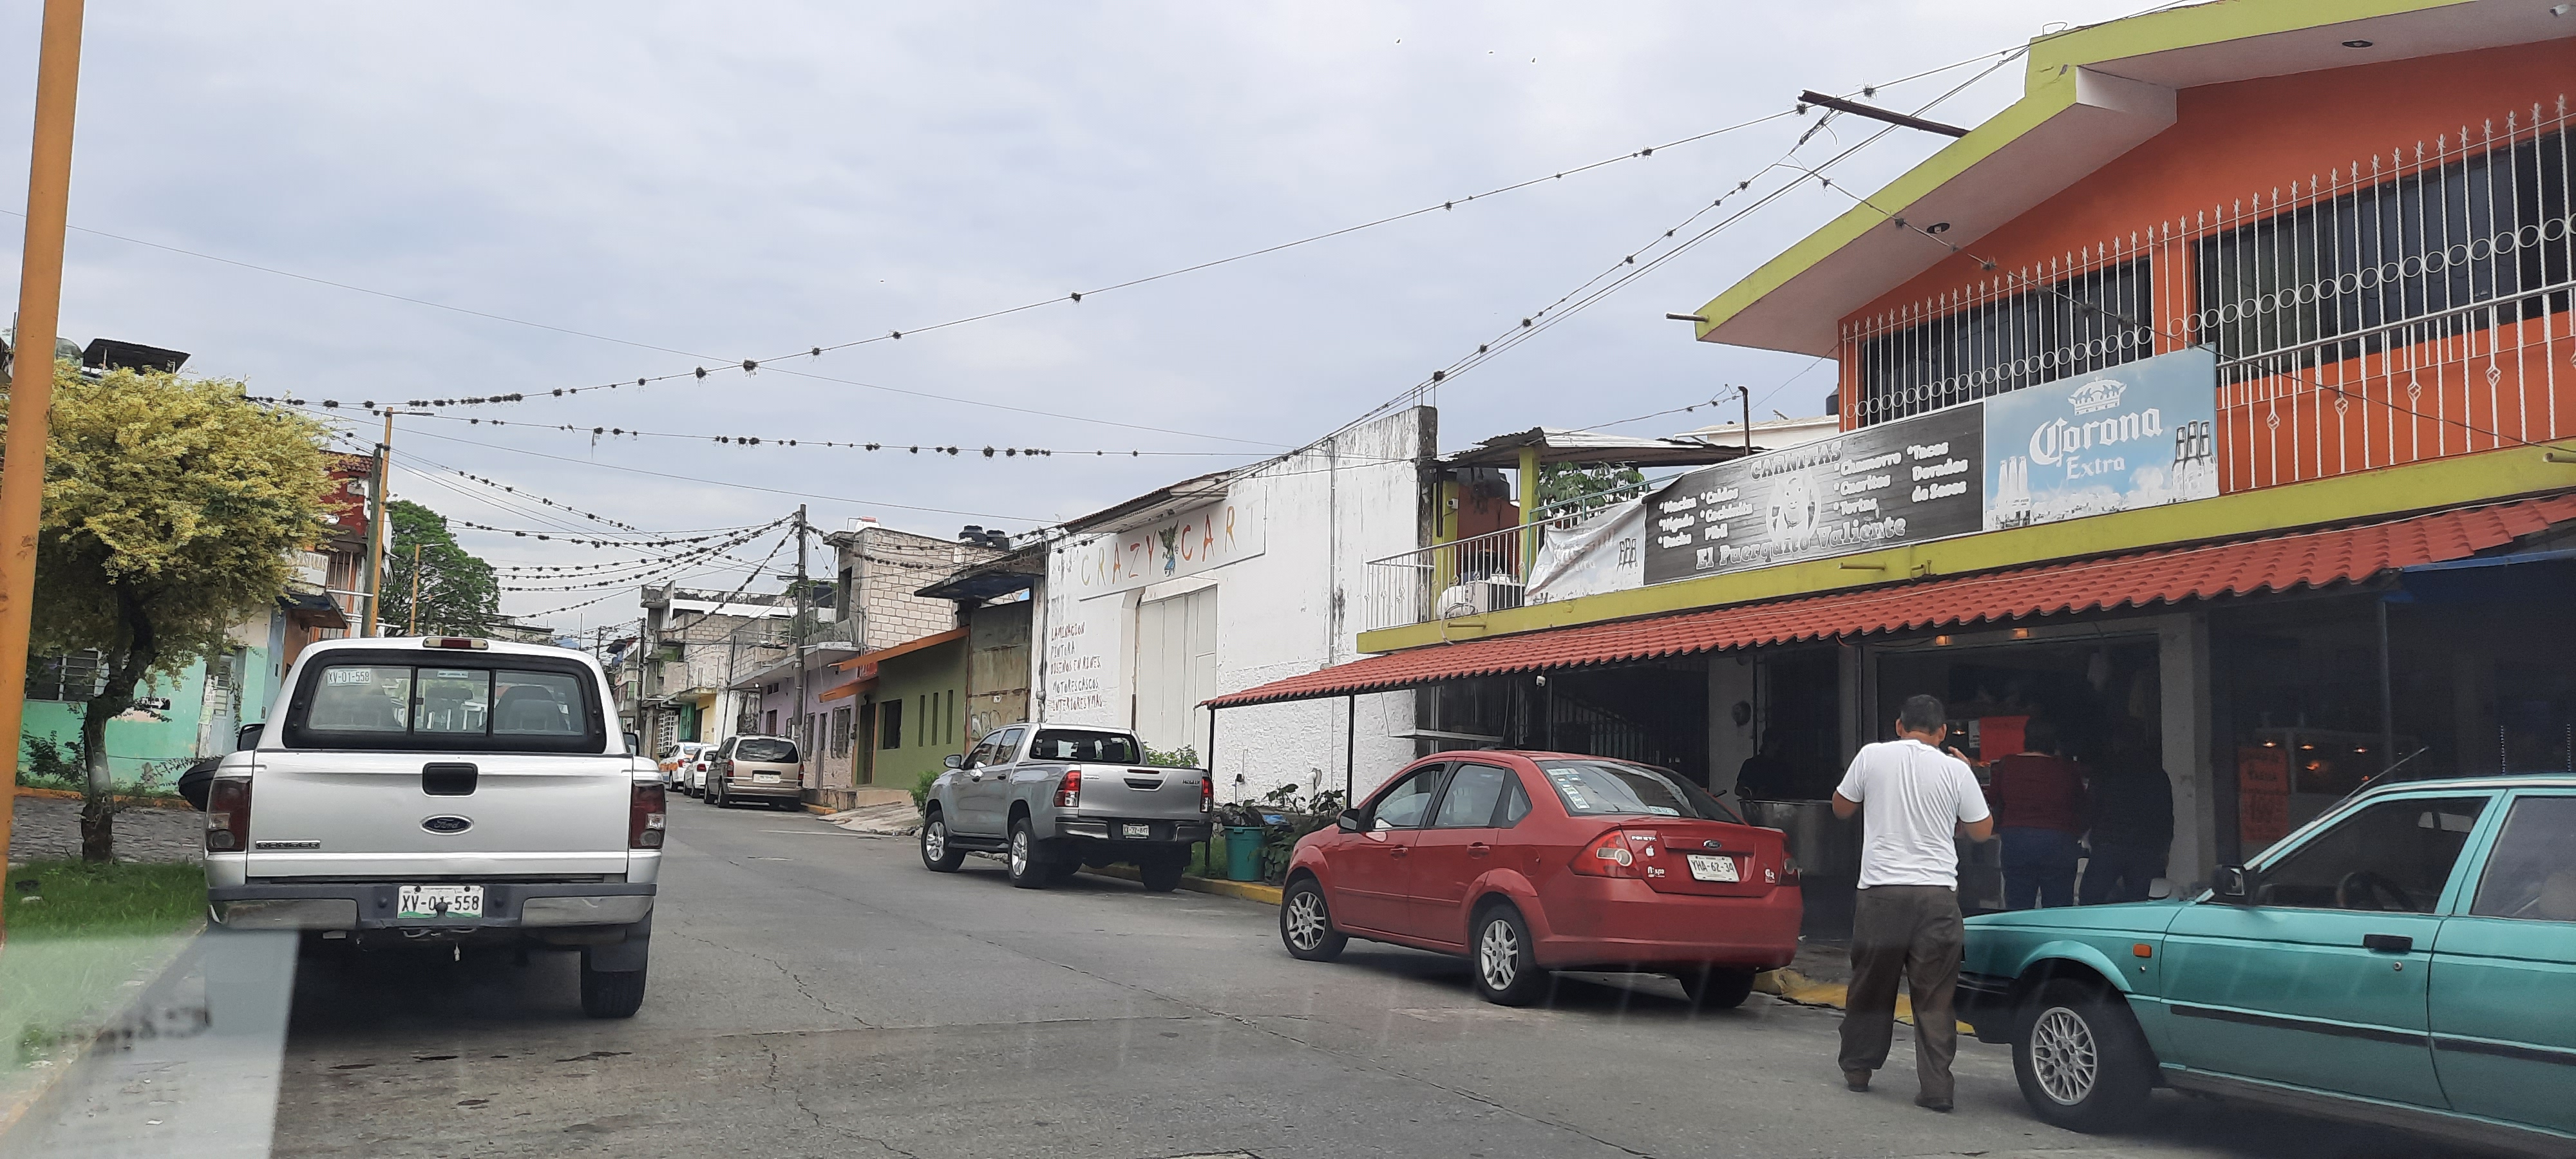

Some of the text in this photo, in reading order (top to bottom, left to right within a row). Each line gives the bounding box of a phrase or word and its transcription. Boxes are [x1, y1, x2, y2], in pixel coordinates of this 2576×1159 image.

[2029, 408, 2163, 468] Corona
[1750, 440, 1842, 481] CARNITAS
[1911, 458, 1969, 482] Dorados
[2065, 455, 2125, 480] Extra
[1696, 516, 1907, 570] El Puerquito Valiente
[1081, 530, 1158, 586] CRAZY
[1050, 640, 1075, 659] PINTURA
[1074, 657, 1081, 672] EN
[328, 671, 370, 683] XV-01-558
[1053, 678, 1077, 693] MOTORES
